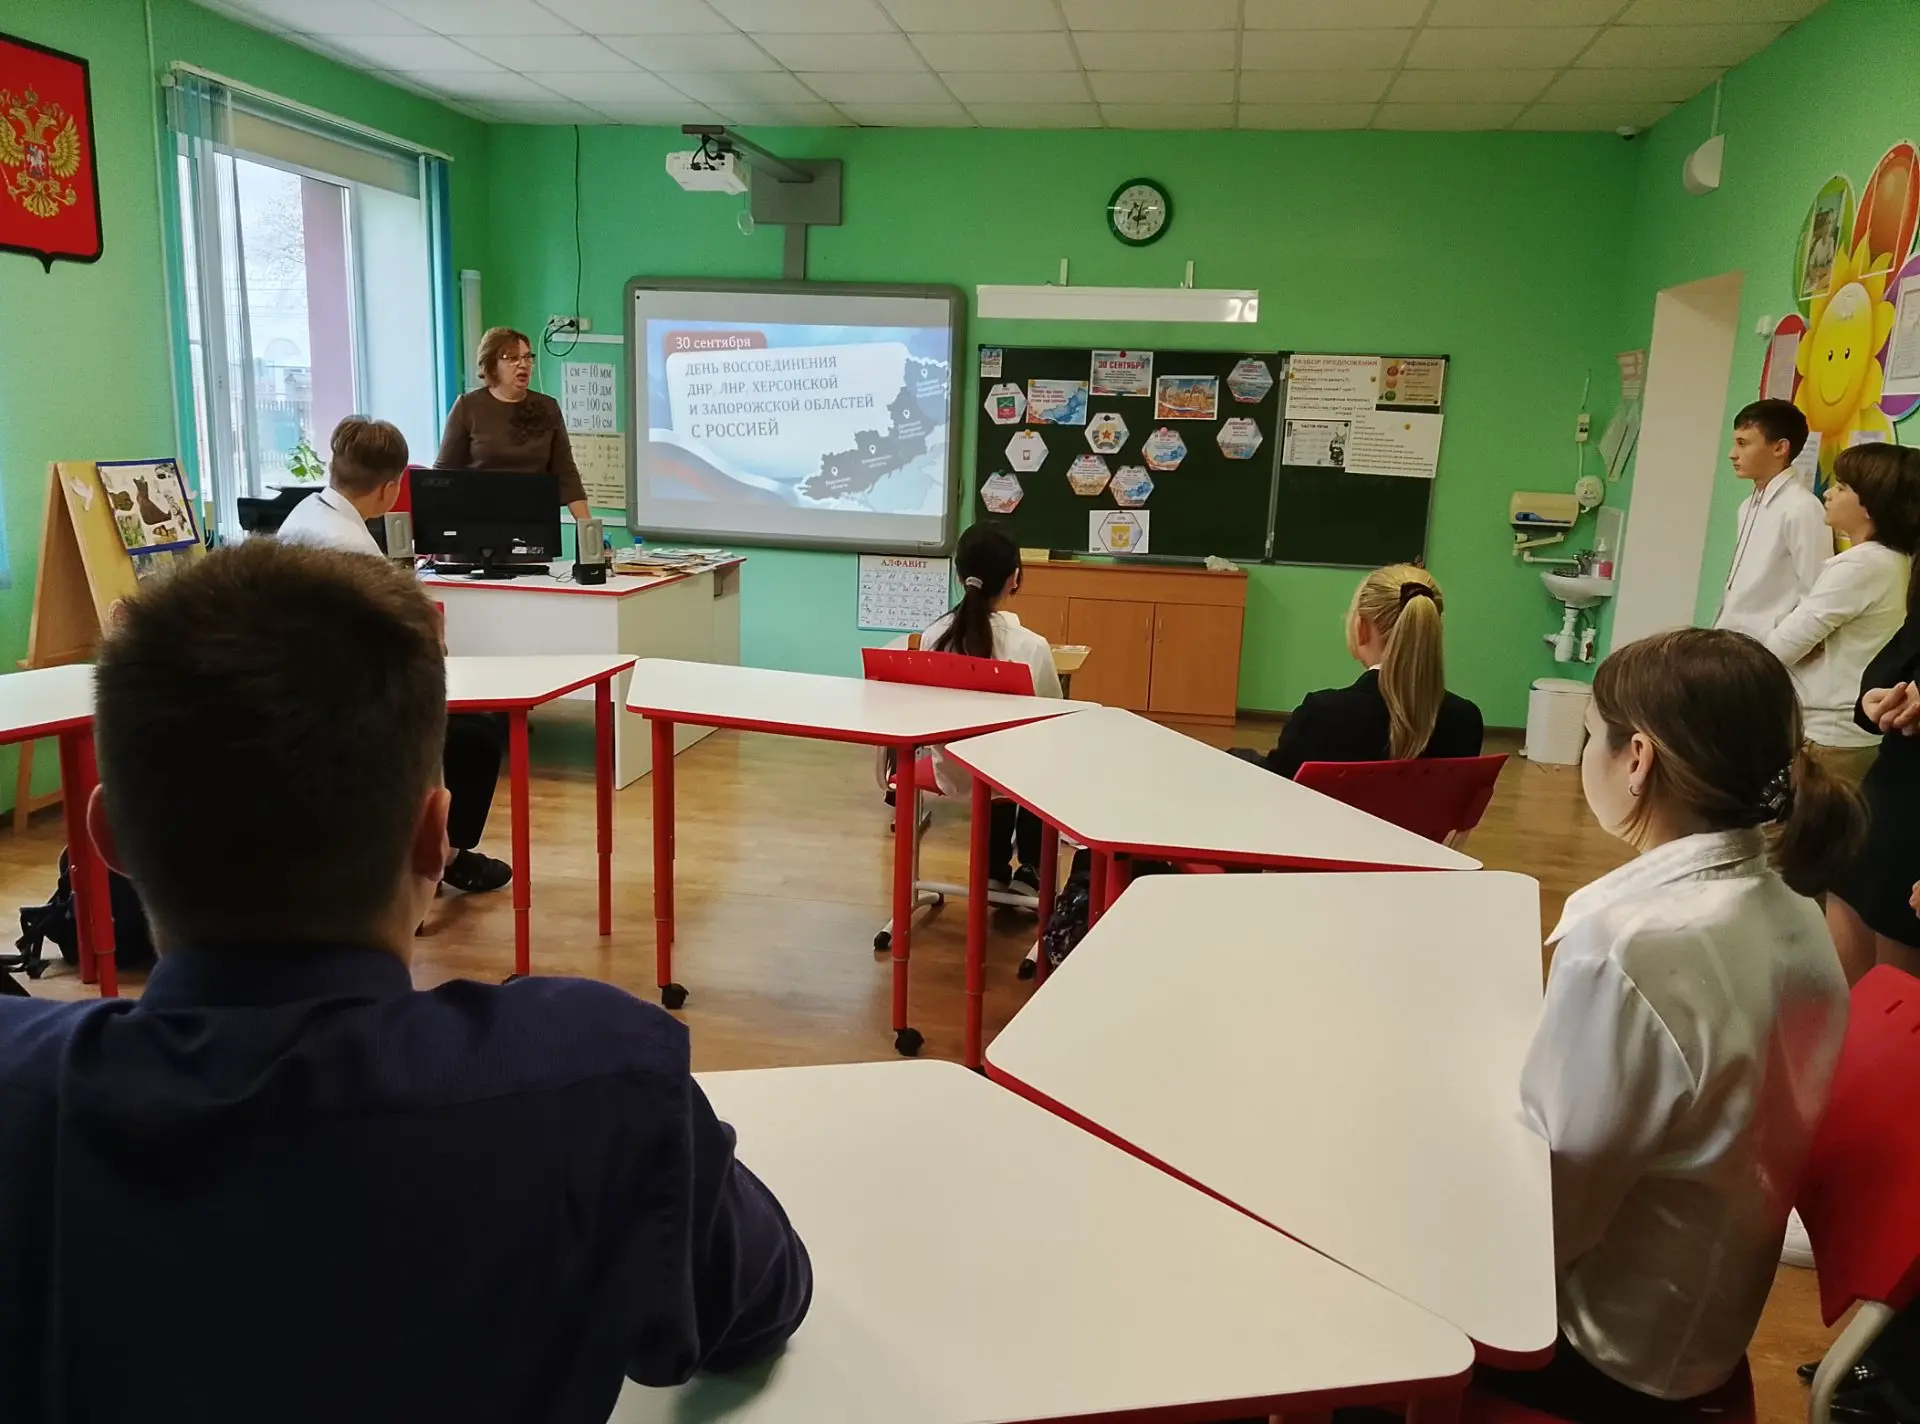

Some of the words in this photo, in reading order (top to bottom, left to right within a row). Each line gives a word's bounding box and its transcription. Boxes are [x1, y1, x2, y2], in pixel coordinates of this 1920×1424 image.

[676, 336, 691, 350] 30
[694, 336, 751, 351] сентября
[570, 367, 580, 377] см
[590, 365, 598, 378] 10
[600, 368, 612, 379] мм
[685, 361, 719, 377] ДЕНЬ
[723, 356, 837, 374] ВОССОЕДИНЕНИЯ
[571, 384, 577, 394] м
[588, 381, 598, 395] 10
[600, 386, 612, 396] дм
[752, 375, 838, 393] ХЕРСОНСКОЙ
[587, 398, 600, 412] 100
[601, 402, 613, 412] см
[689, 403, 698, 416] И
[702, 399, 800, 416] ЗАПОРОЖСКОЙ
[804, 396, 875, 412] ОБЛАСТЕЙ
[571, 417, 582, 428] дм
[592, 415, 601, 428] 10
[602, 418, 613, 428] см
[691, 424, 701, 439] С
[706, 418, 779, 438] РОССИЕЙ
[880, 559, 928, 569] АЛФАВИТ
